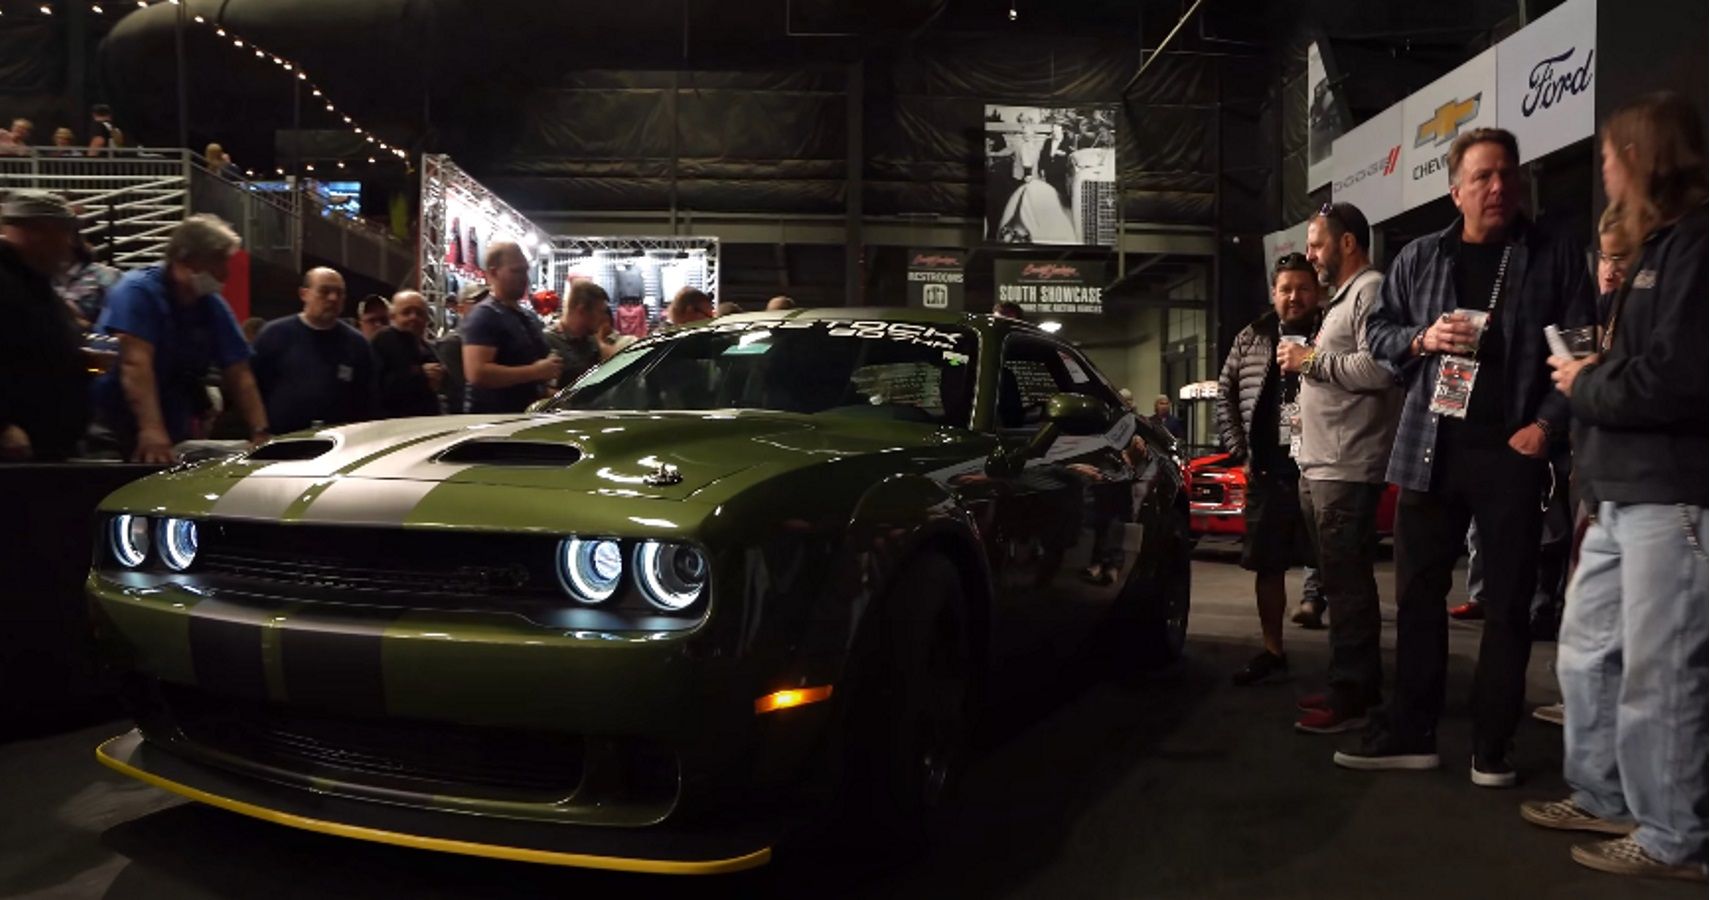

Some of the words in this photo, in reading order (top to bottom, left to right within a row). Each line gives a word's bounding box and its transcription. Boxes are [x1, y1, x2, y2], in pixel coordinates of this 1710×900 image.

[1521, 47, 1594, 117] Ford
[1334, 158, 1388, 193] DODGE
[907, 271, 964, 283] RESTROOMS
[999, 285, 1037, 303] SOUTH
[1040, 285, 1103, 304] SHOWCASE
